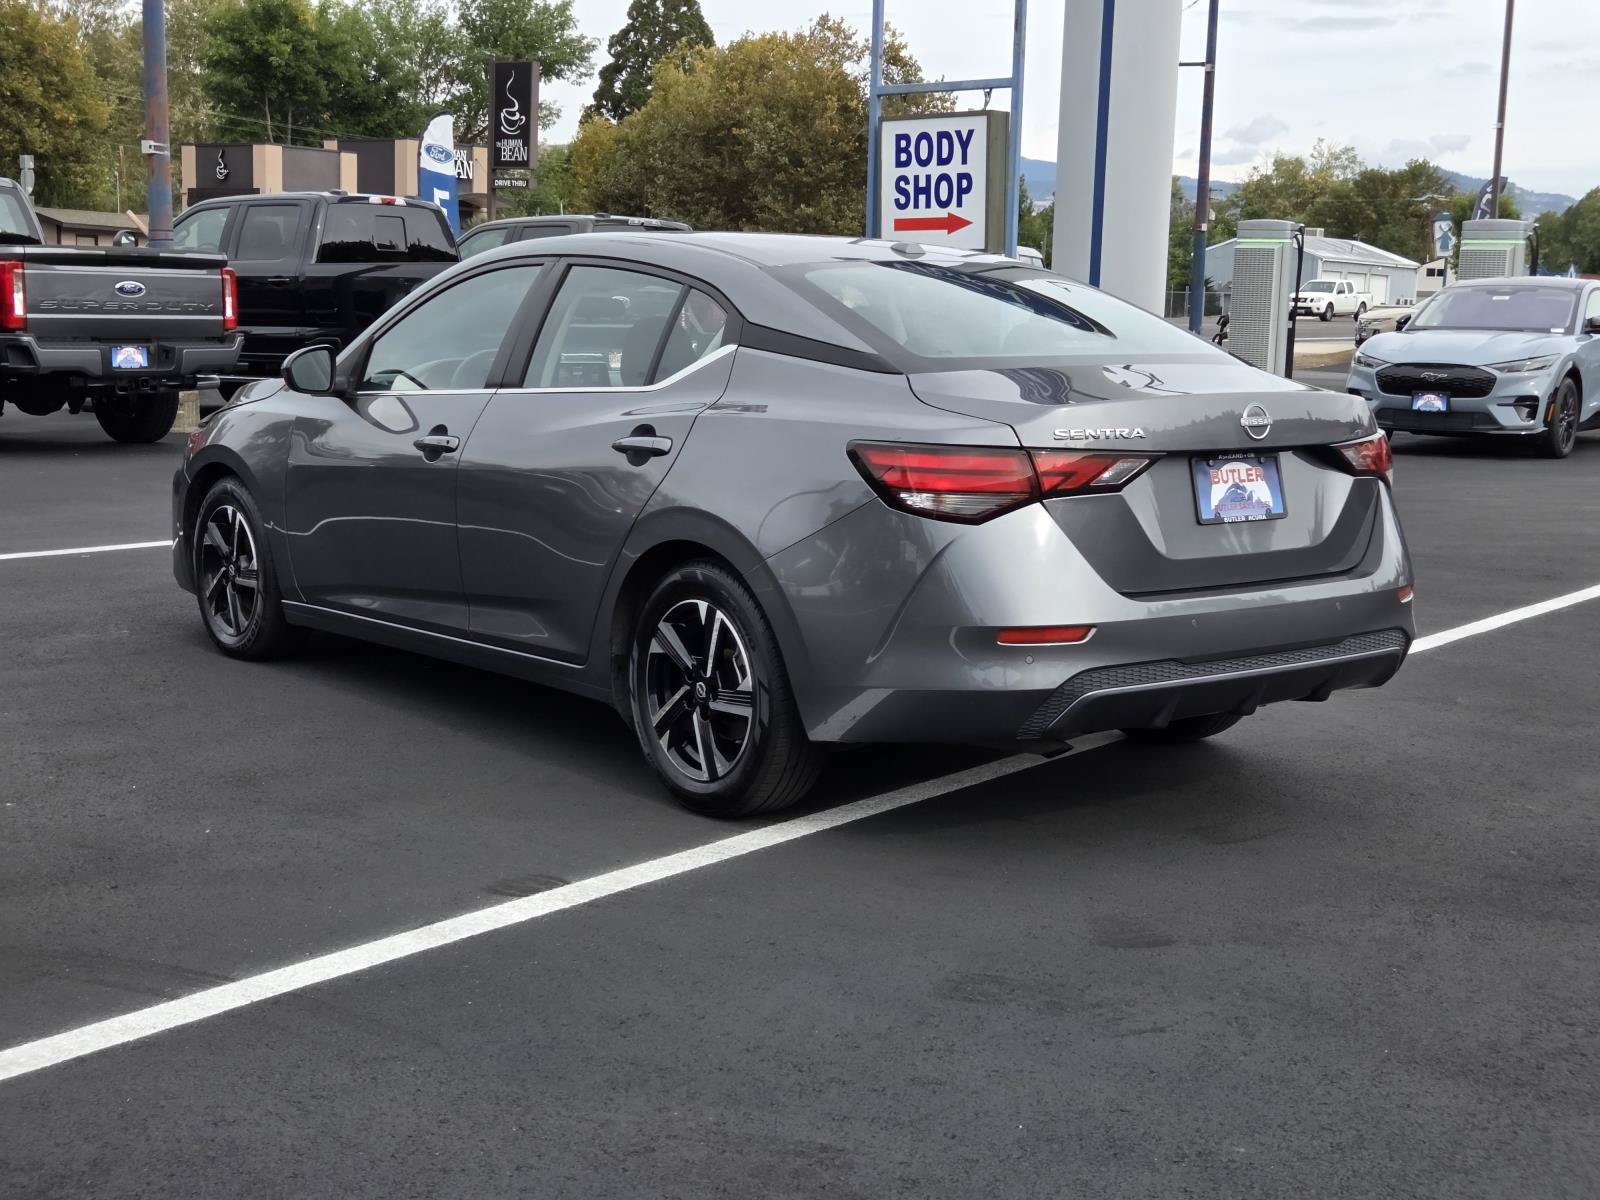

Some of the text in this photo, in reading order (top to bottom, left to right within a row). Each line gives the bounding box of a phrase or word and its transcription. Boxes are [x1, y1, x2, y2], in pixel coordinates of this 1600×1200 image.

[501, 139, 523, 148] HUMAN
[895, 129, 975, 168] BODY
[501, 147, 528, 161] BEAN
[894, 172, 973, 210] SHOP
[39, 300, 214, 311] SUPER DUTY
[1241, 417, 1273, 426] NISSAN
[1053, 427, 1147, 440] SENTRA
[1210, 467, 1264, 485] BUTLER
[1223, 513, 1267, 523] BUTLER ACURA
